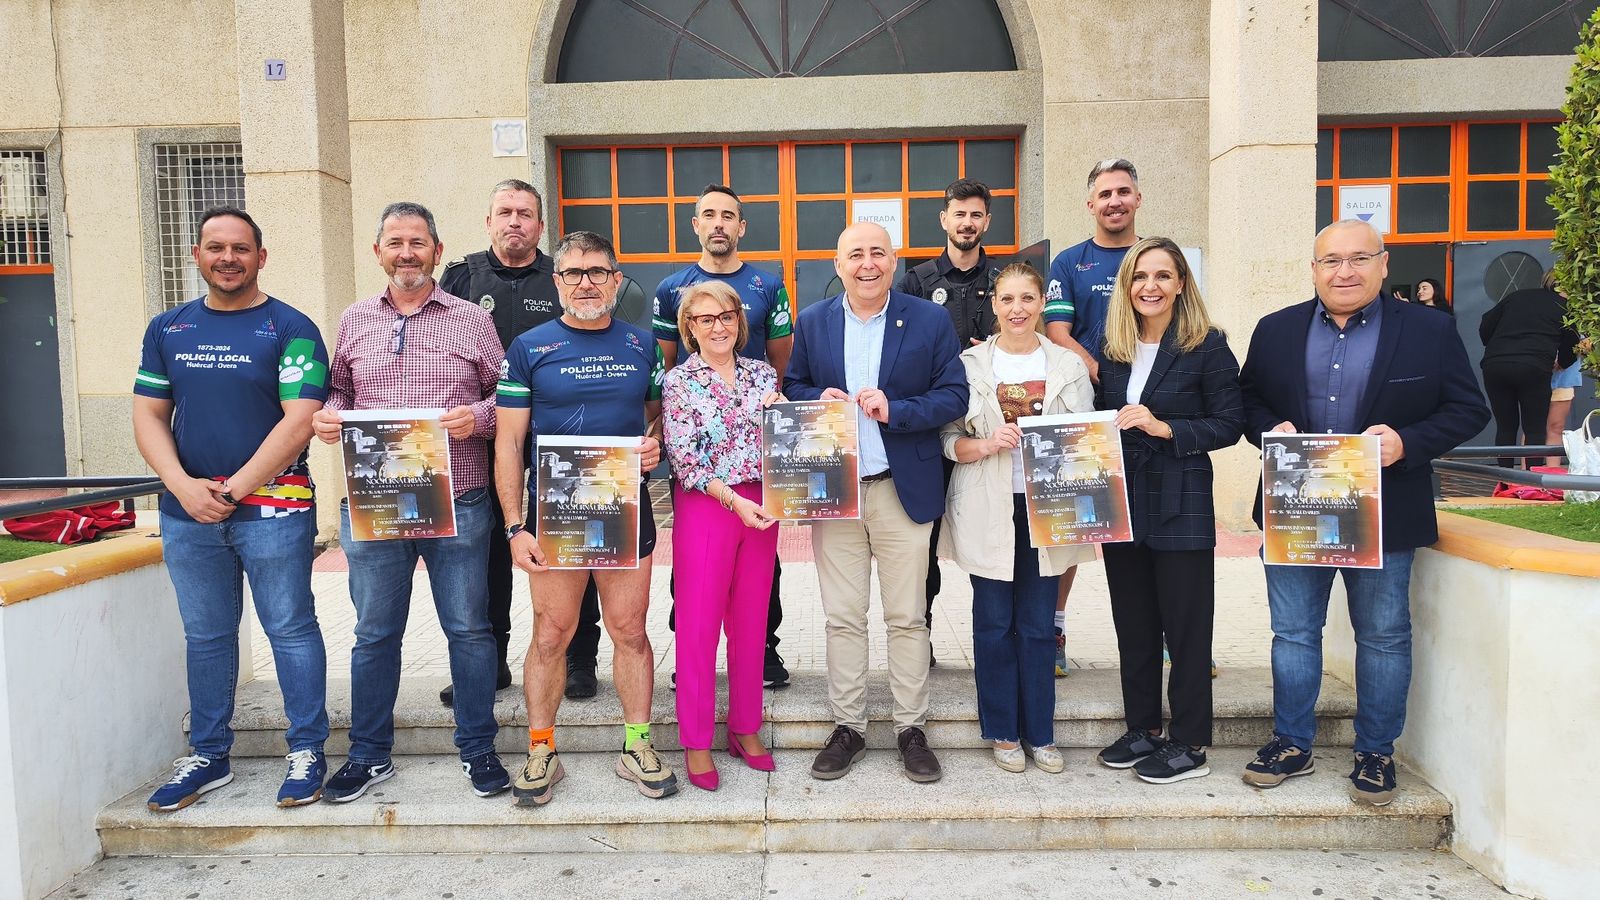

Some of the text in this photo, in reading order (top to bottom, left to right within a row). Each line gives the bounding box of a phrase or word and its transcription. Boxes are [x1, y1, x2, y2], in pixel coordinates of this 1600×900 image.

[267, 63, 284, 76] 17
[1346, 201, 1383, 209] SALIDA
[858, 215, 896, 224] ENTRADA
[523, 298, 553, 306] POLICIA
[525, 304, 552, 312] LOCAL
[175, 353, 252, 363] POLICÍA LOCAL
[560, 364, 604, 374] POLICÍA
